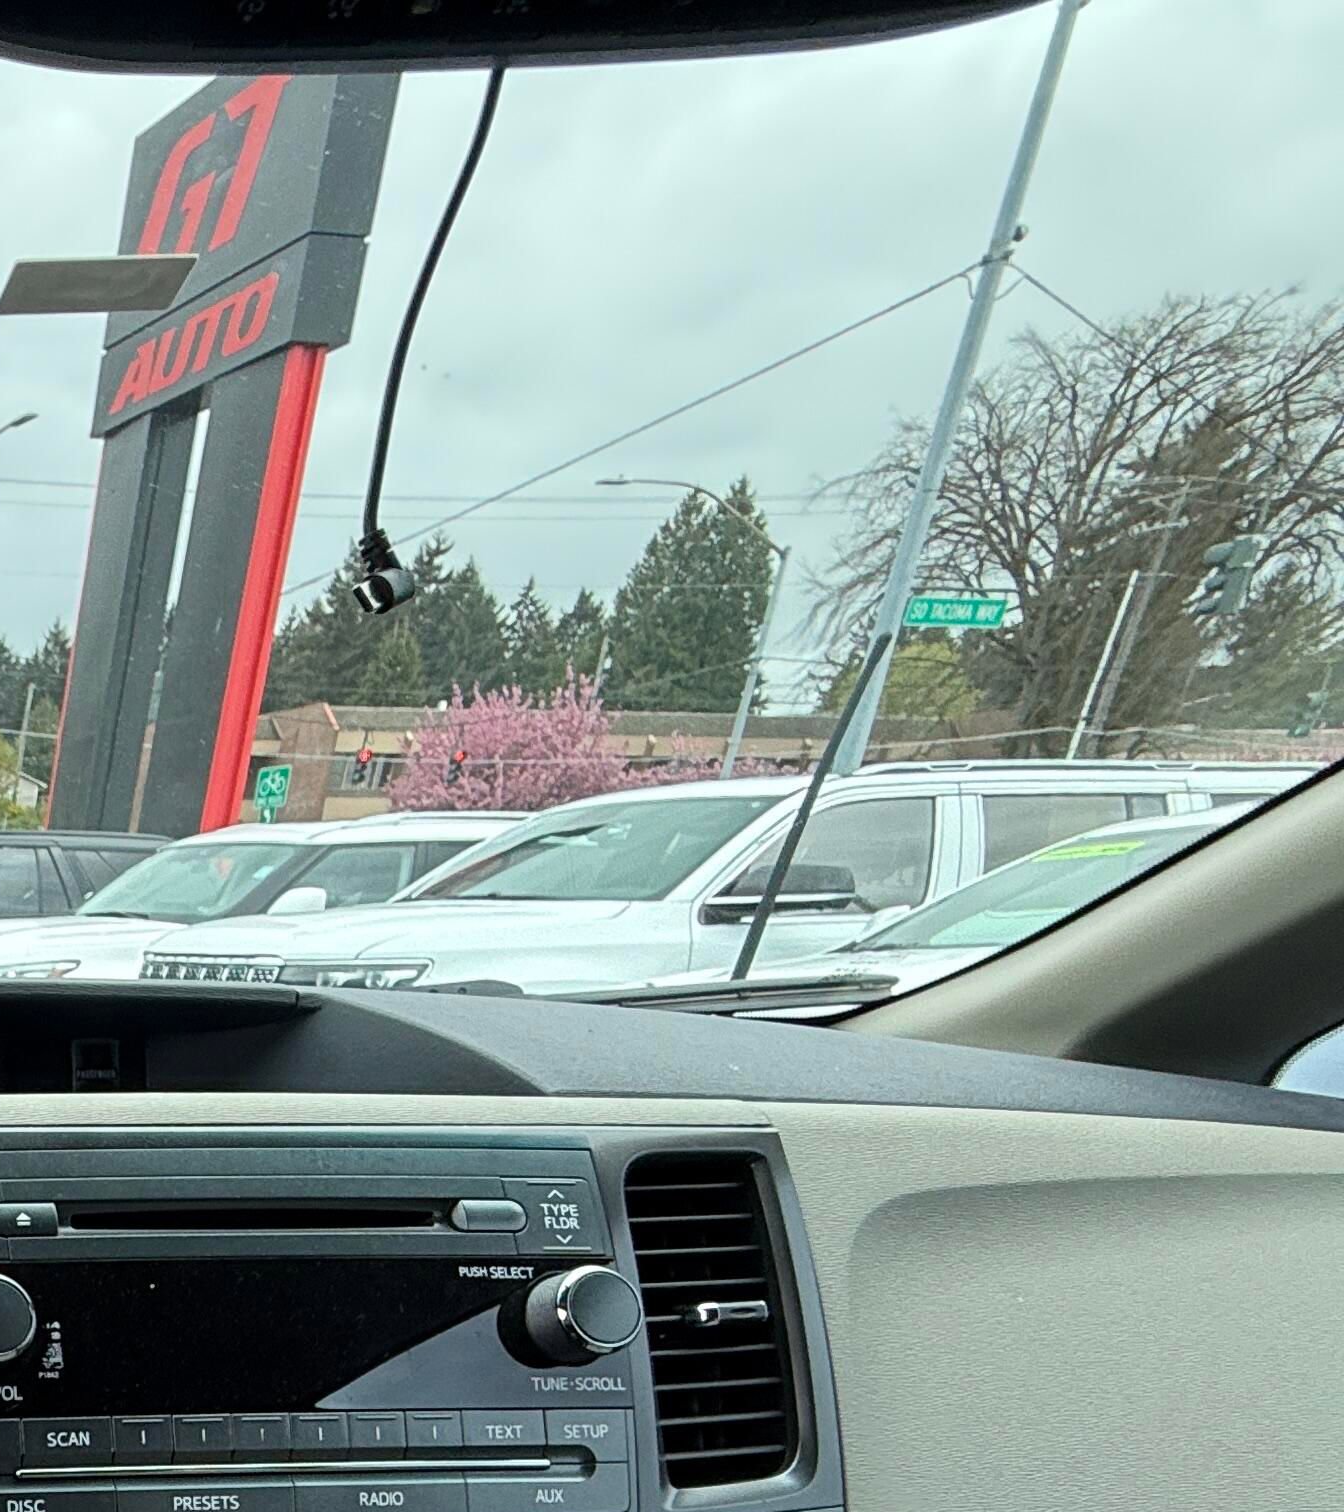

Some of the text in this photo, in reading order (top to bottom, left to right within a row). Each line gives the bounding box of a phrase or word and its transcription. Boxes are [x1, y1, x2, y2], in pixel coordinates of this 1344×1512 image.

[109, 272, 279, 415] AUTO
[540, 1203, 580, 1217] TYPE
[544, 1216, 580, 1230] FLDR
[458, 1266, 534, 1280] PUSH SELECT
[47, 1431, 90, 1448] SCAN
[485, 1424, 523, 1440] TEXT
[563, 1424, 610, 1439] SETUP
[173, 1495, 240, 1512] PRESETS
[359, 1491, 404, 1507] RADIO
[535, 1488, 564, 1504] AUX
